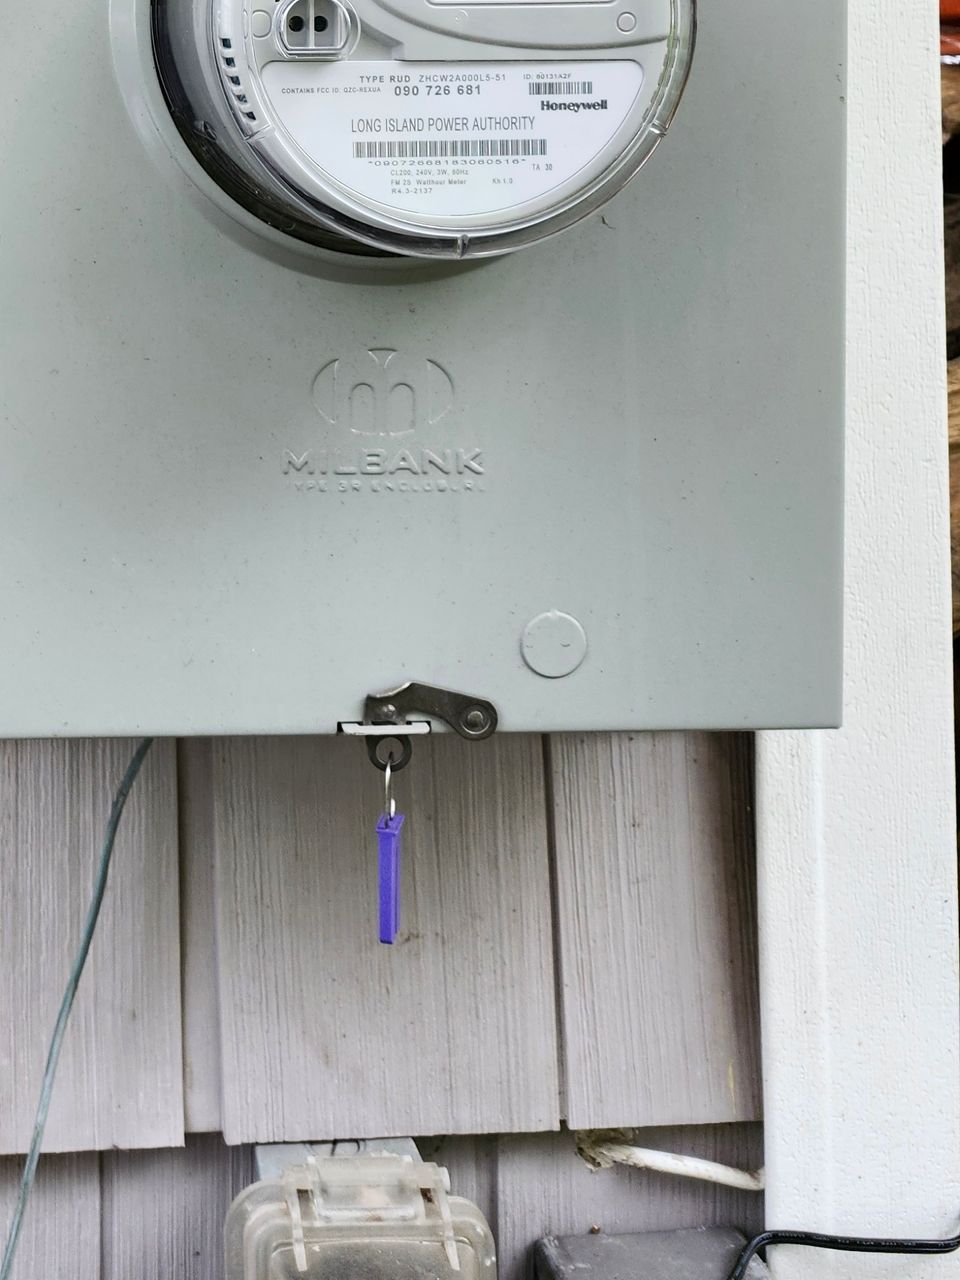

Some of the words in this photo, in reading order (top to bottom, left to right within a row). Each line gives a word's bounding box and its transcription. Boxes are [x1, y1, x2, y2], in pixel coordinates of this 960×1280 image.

[359, 75, 385, 83] TYPE
[390, 75, 411, 83] RUD
[394, 85, 419, 96] 090
[425, 84, 451, 96] 726
[457, 84, 481, 95] 681
[540, 99, 608, 113] Honeywell
[351, 118, 382, 133] LONG
[385, 118, 425, 132] ISLAND
[428, 117, 469, 132] POWER
[472, 116, 536, 131] AUTHORITY
[532, 163, 541, 171] TA
[544, 163, 553, 171] 30
[283, 448, 485, 475] MILBANK
